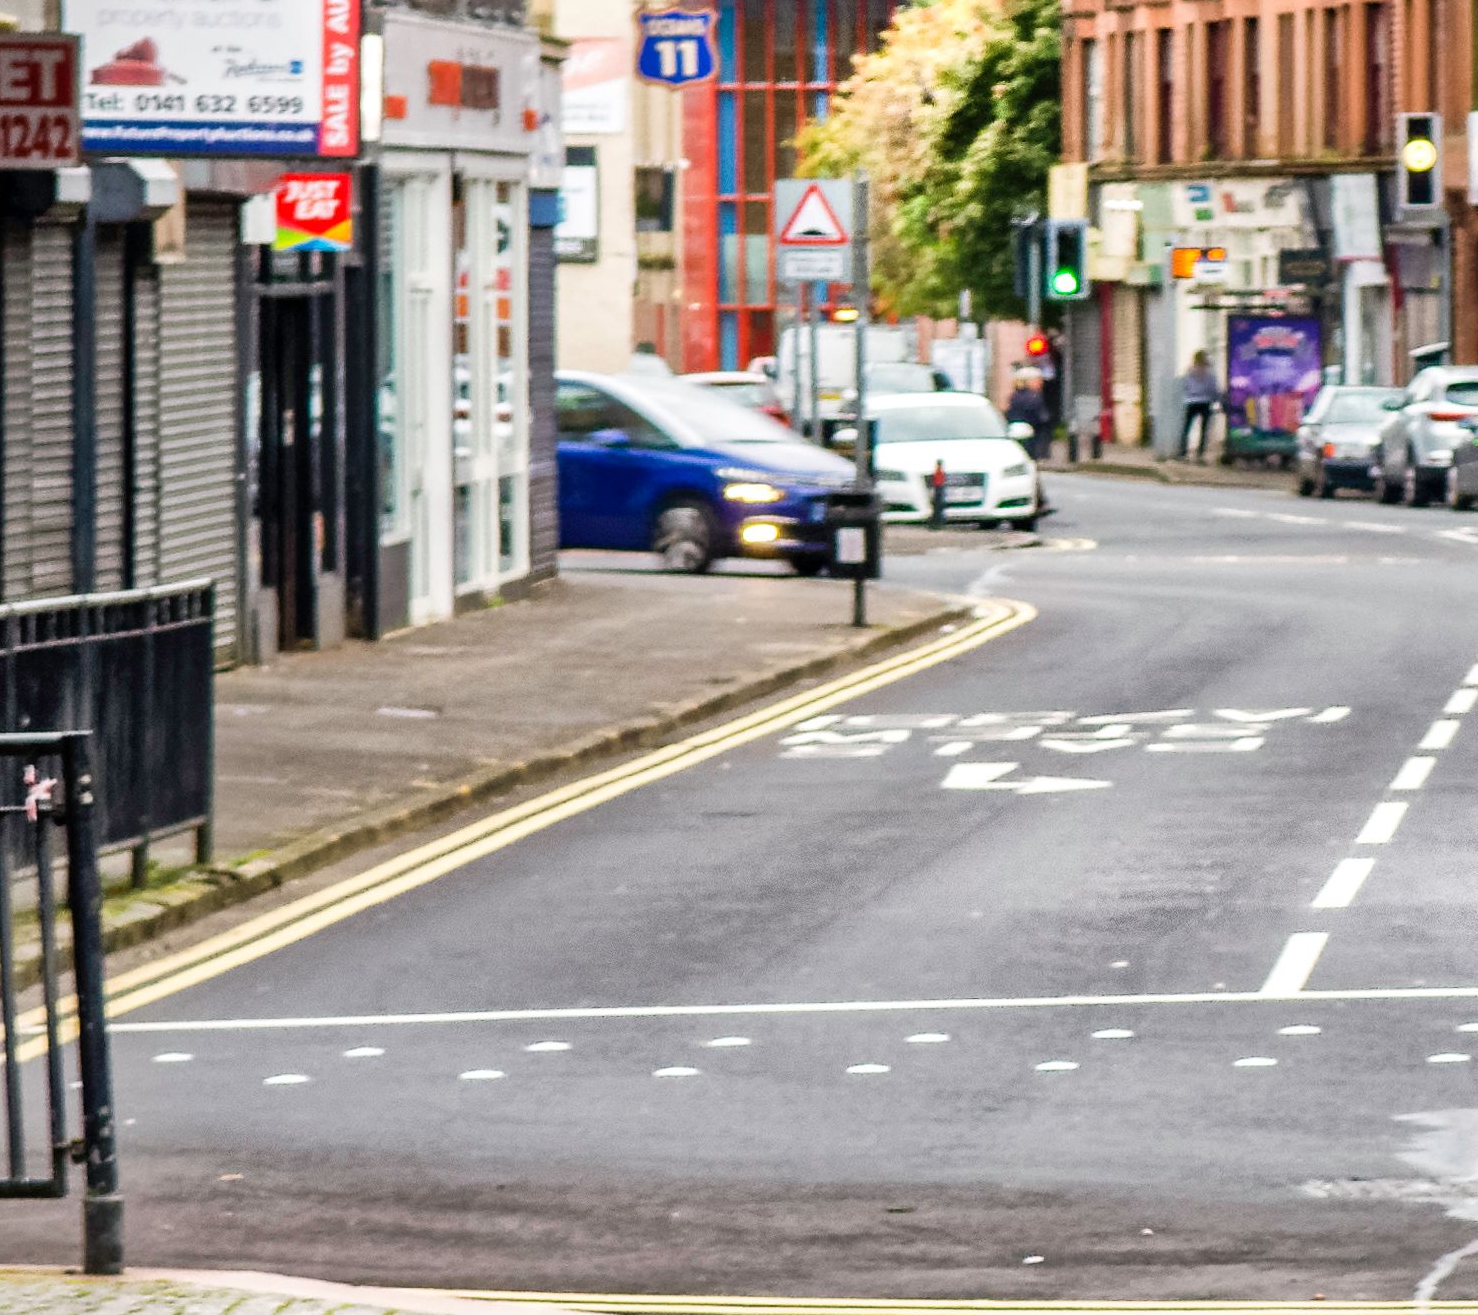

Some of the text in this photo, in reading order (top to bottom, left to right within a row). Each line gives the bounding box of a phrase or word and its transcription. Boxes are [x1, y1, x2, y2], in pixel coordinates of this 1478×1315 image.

[324, 42, 355, 76] by
[654, 40, 699, 77] 11
[135, 93, 184, 112] 0141
[195, 94, 237, 113] 632
[247, 95, 305, 114] 6599
[324, 84, 350, 148] SALE
[284, 180, 342, 203] JUST
[294, 199, 342, 220] EAT
